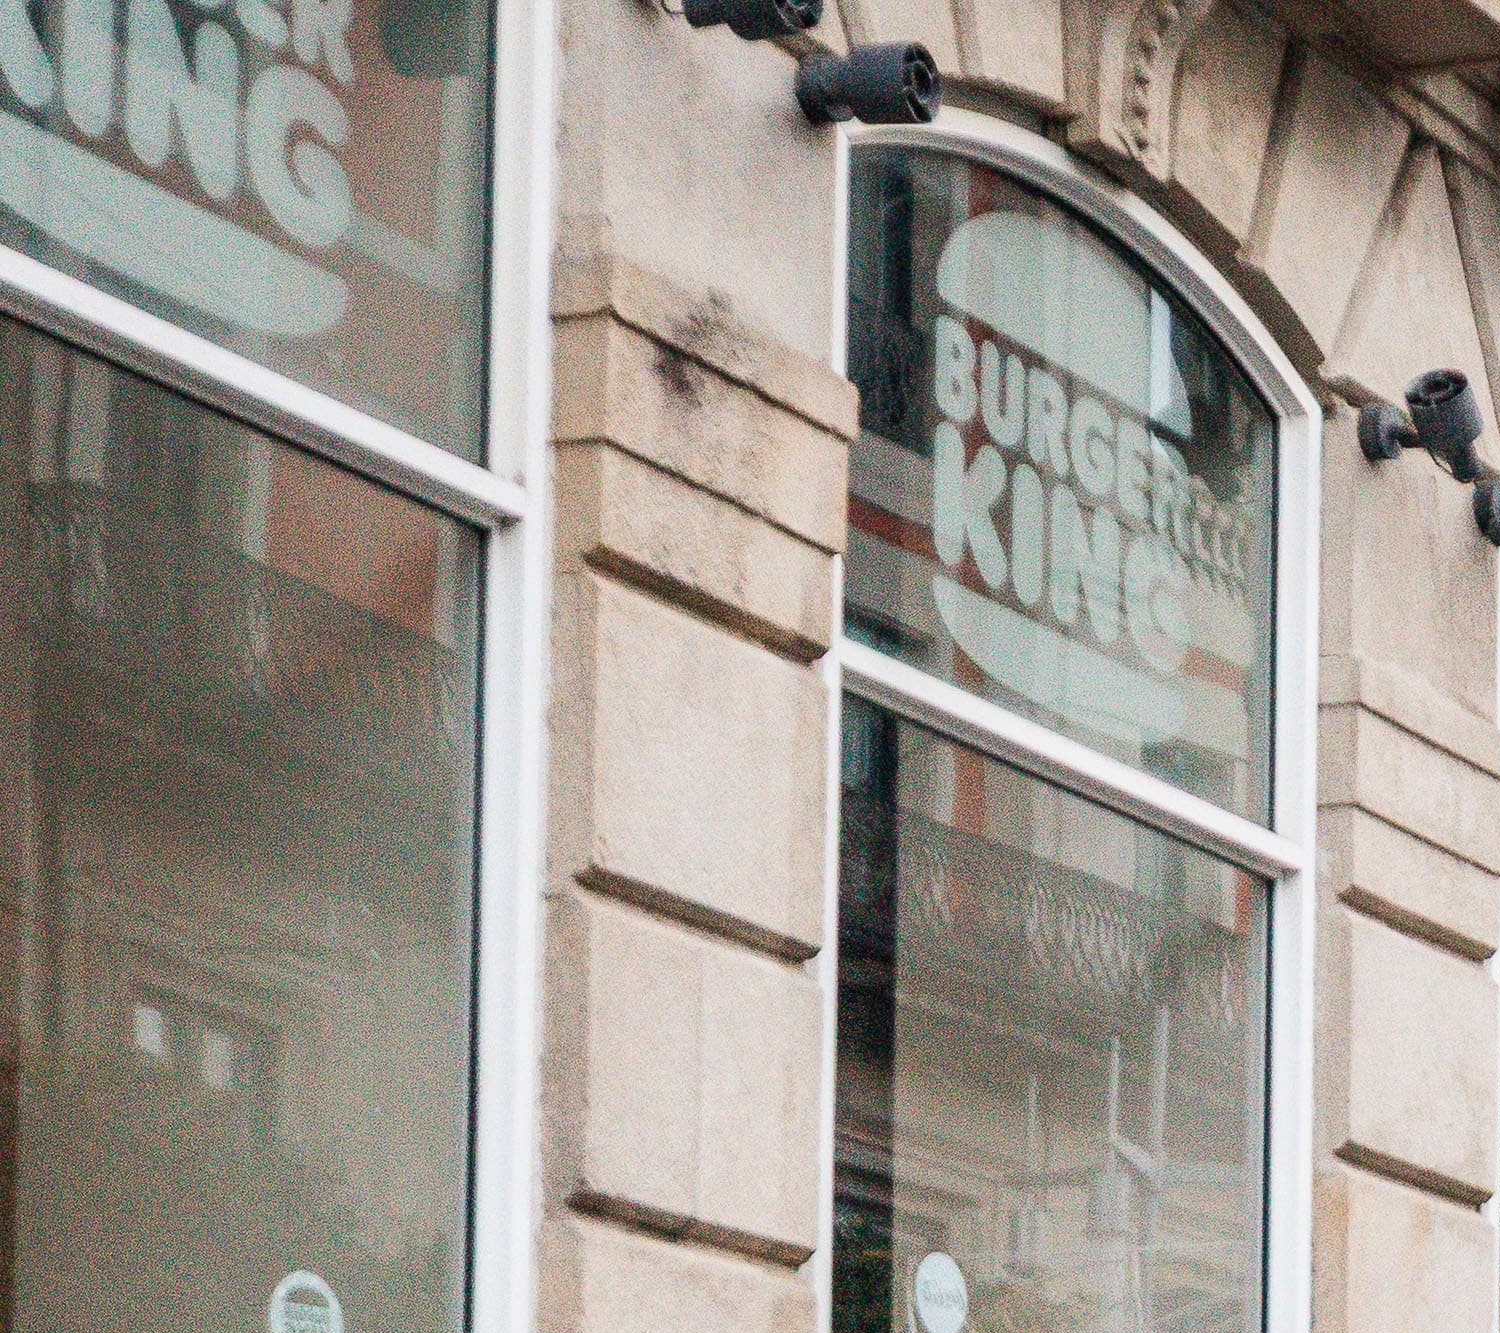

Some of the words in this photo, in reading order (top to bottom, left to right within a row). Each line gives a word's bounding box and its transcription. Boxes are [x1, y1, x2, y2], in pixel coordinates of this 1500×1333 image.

[0, 0, 351, 248] ING
[933, 421, 1190, 676] KING
[935, 313, 1193, 560] BURGER
